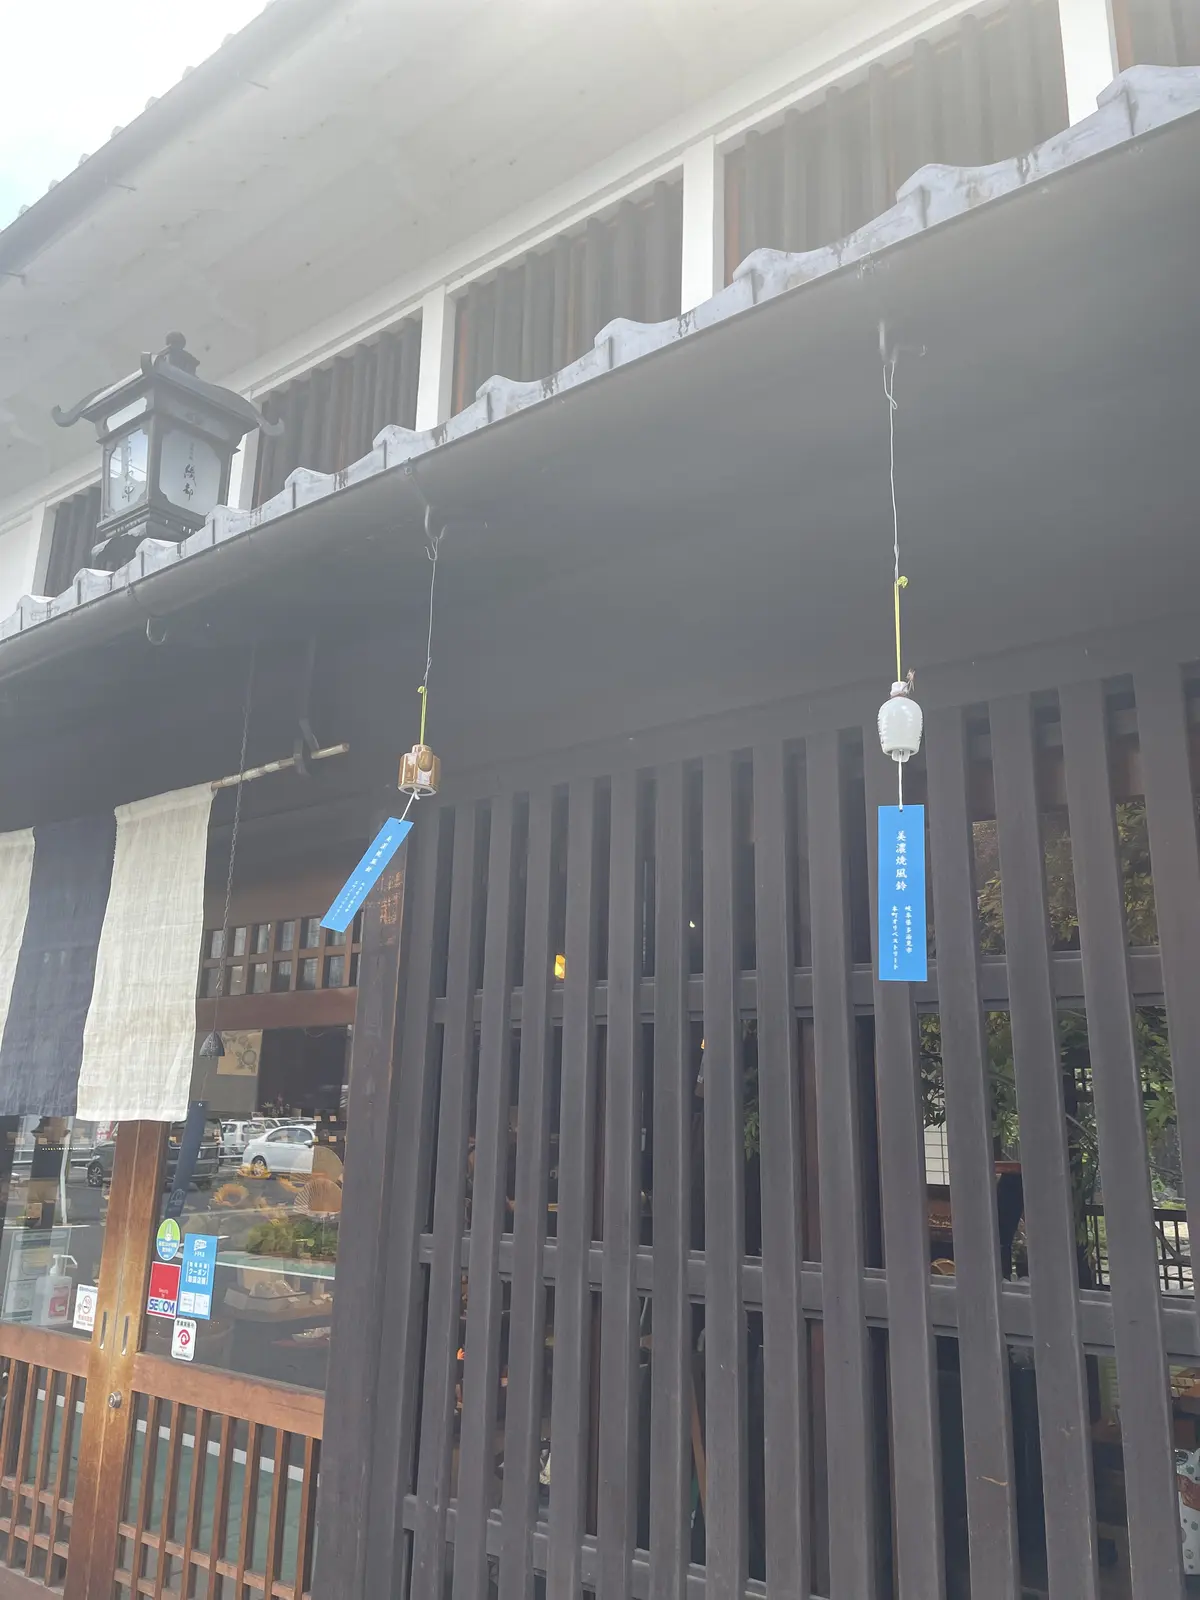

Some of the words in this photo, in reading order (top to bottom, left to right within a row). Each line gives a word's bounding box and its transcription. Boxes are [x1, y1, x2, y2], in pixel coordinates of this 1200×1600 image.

[895, 830, 908, 892] 美濃焼風鈴
[188, 1267, 207, 1276] クーポン
[149, 1298, 175, 1314] SECOM
